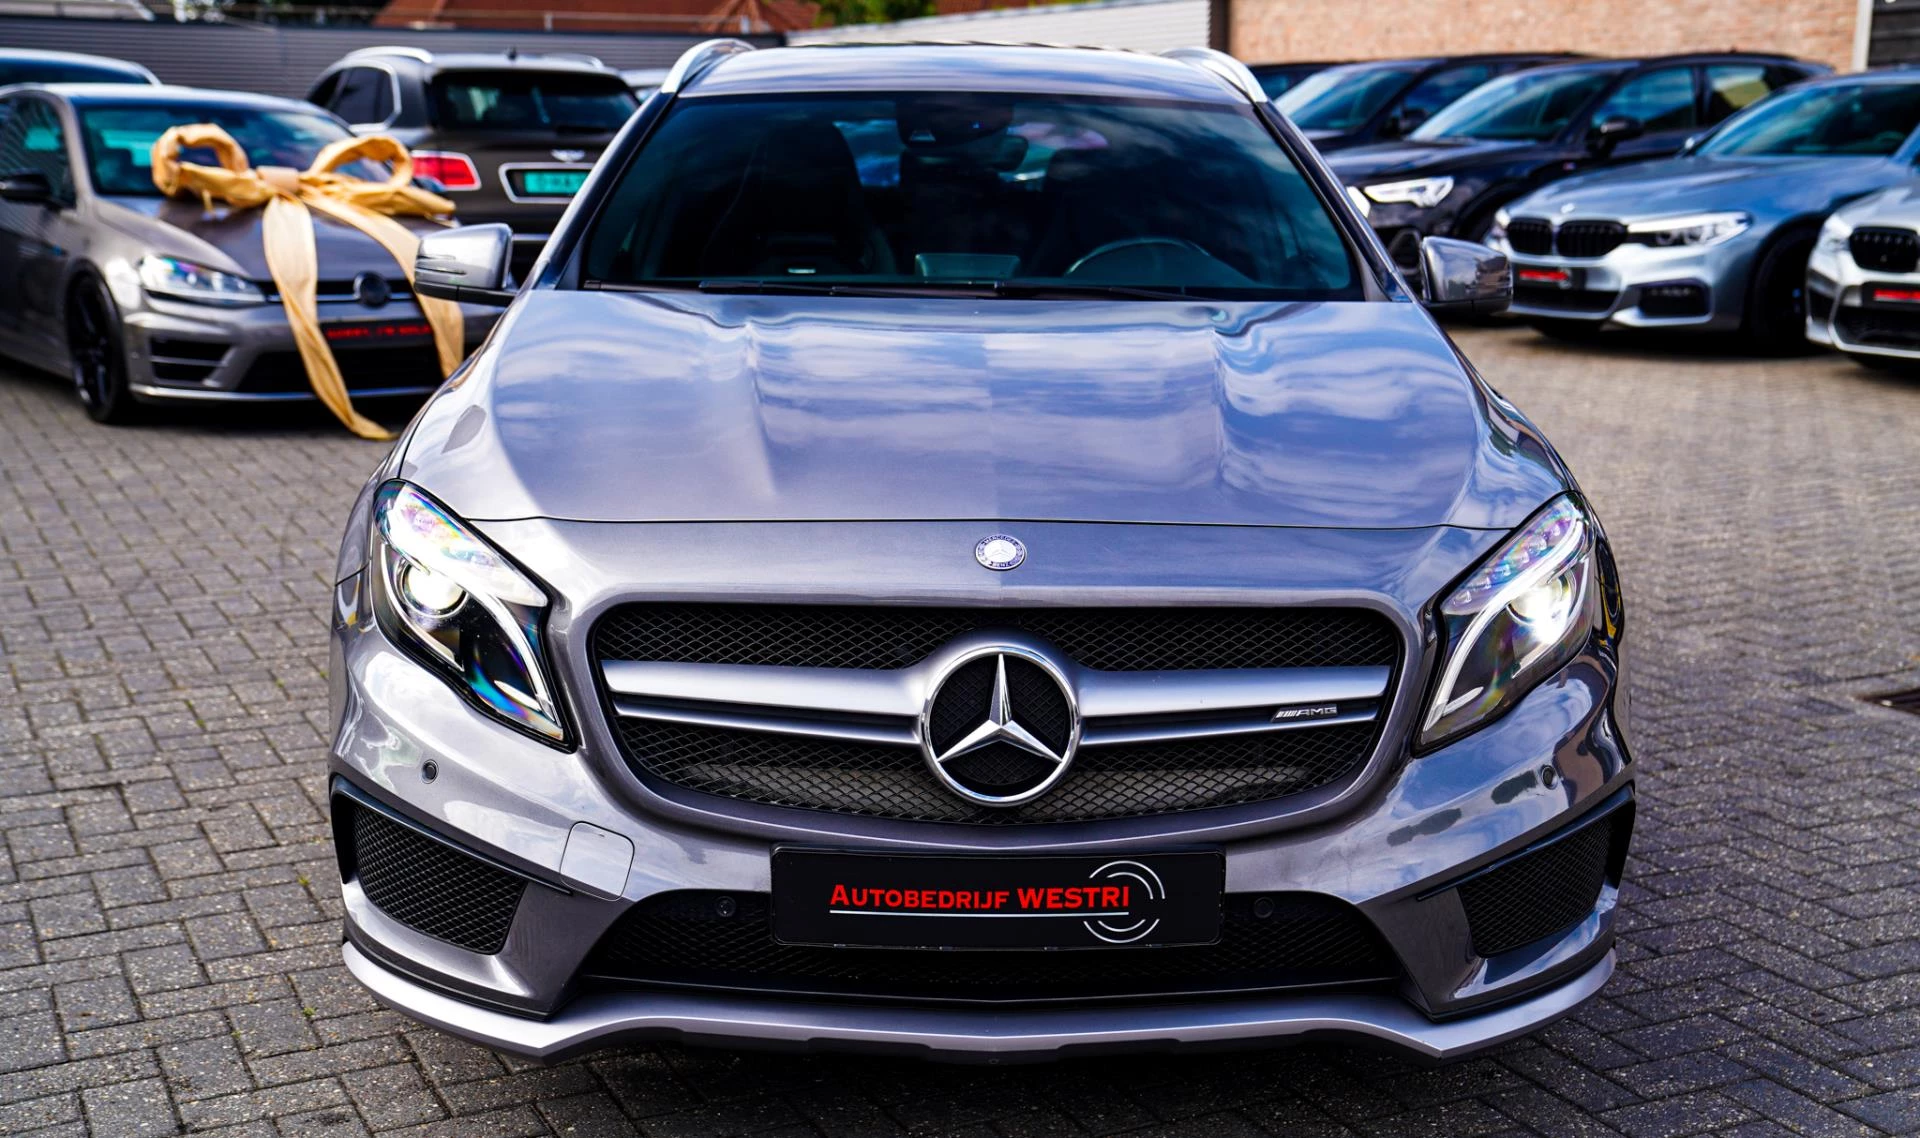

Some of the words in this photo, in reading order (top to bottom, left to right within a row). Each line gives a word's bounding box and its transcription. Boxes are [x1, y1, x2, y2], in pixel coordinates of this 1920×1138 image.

[1296, 706, 1337, 717] AMG
[831, 884, 1010, 909] AUTOBEDRIJF
[1018, 886, 1129, 909] WESTRI
